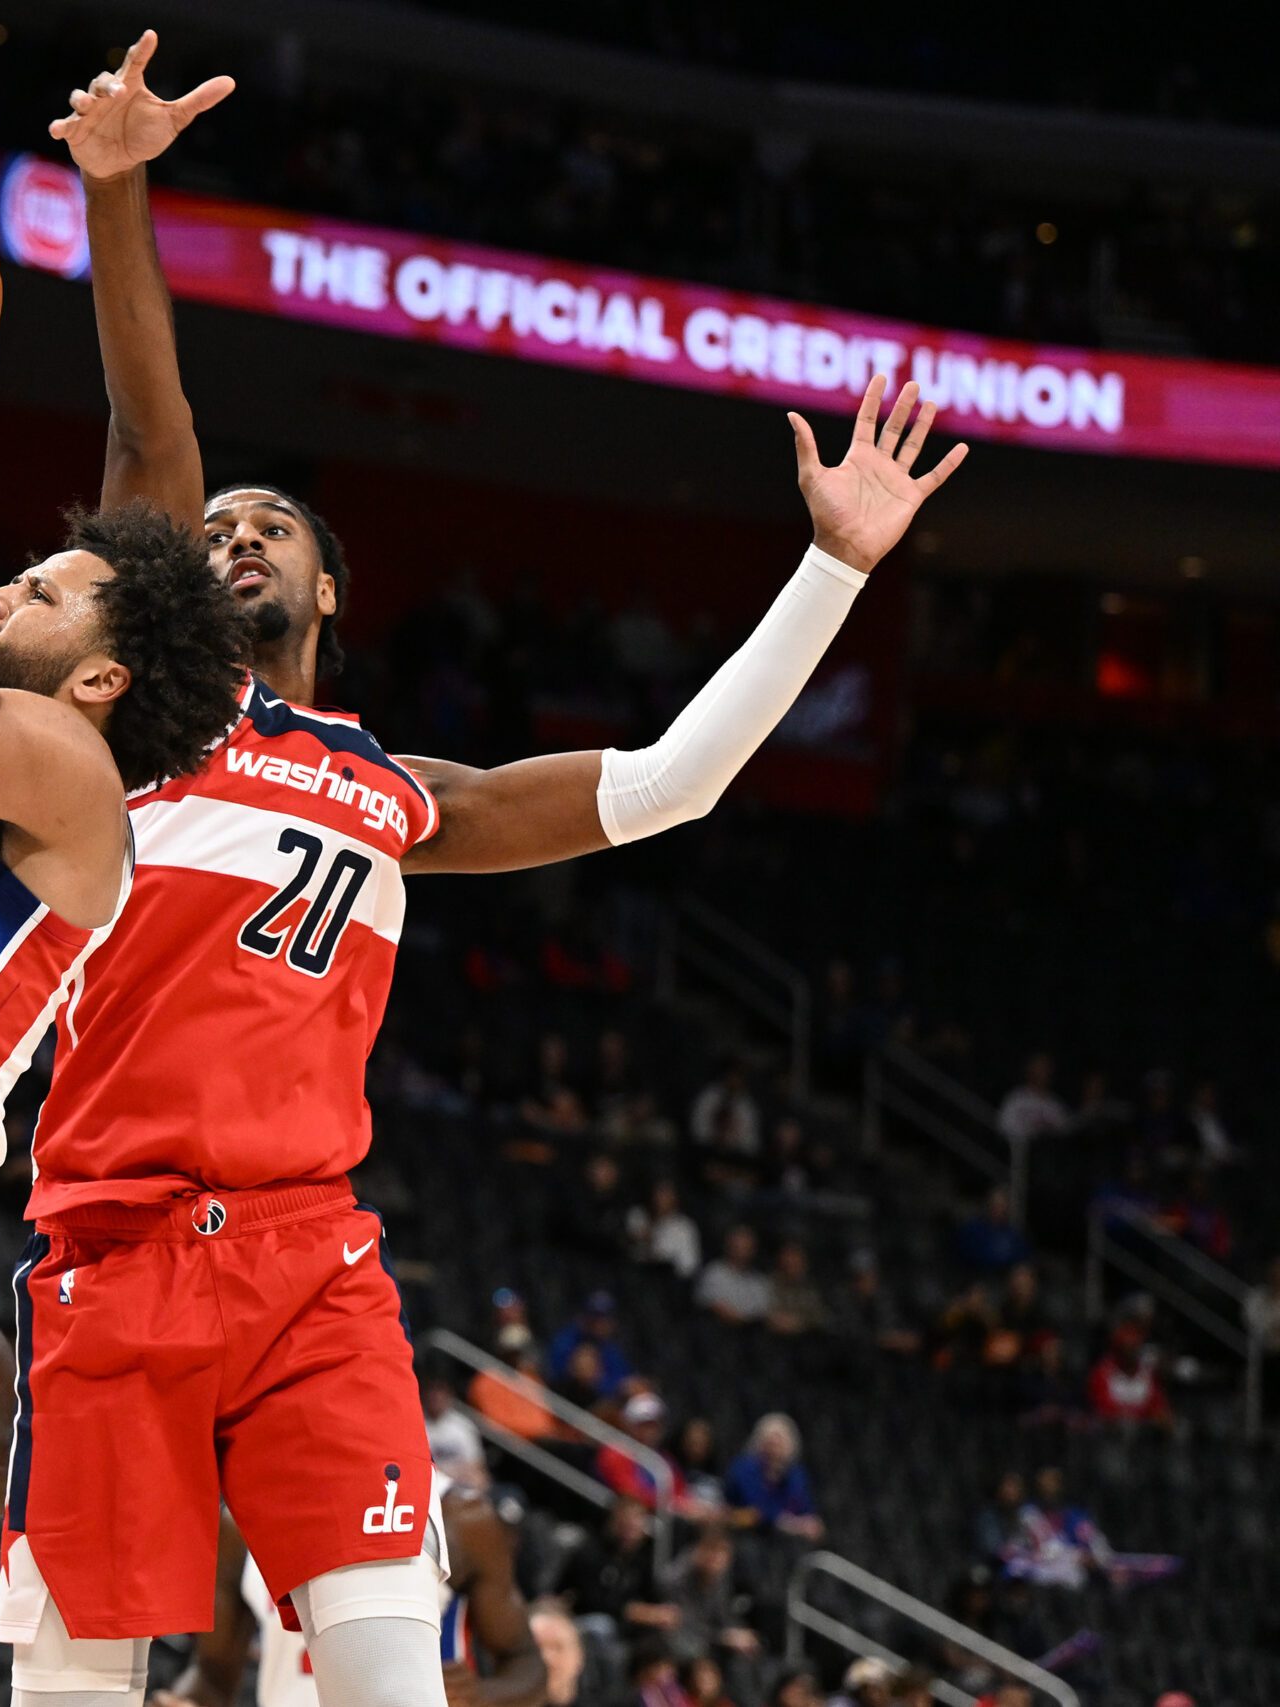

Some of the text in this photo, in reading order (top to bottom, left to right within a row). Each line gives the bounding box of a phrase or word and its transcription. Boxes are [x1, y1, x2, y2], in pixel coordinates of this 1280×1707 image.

[264, 230, 1124, 433] THE OFFICIAL CREDIT UNION
[226, 748, 409, 844] washingto
[237, 827, 374, 978] 20
[362, 1479, 415, 1534] dc
